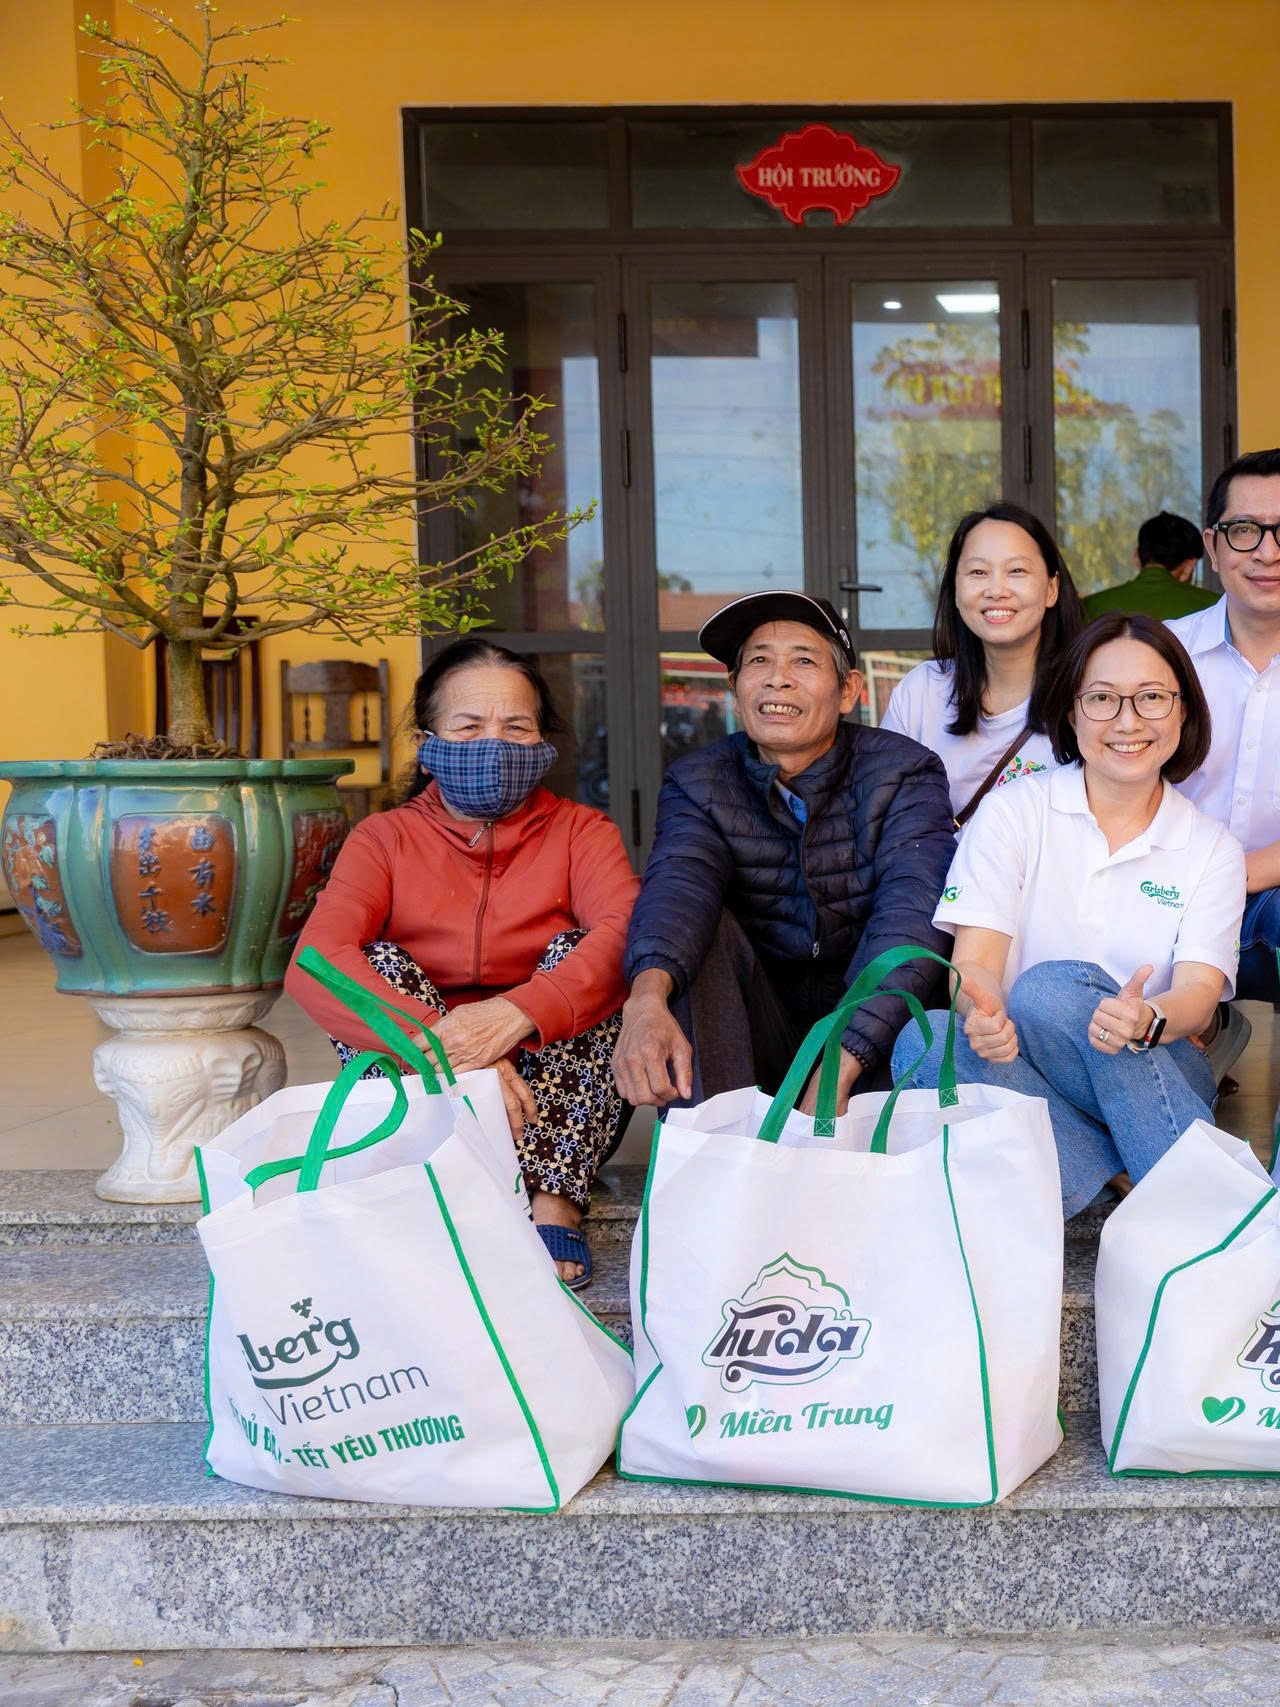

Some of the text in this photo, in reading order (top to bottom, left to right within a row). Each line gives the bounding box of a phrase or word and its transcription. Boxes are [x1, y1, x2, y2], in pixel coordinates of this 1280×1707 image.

[758, 163, 881, 190] HỘI TRƯỜNG
[1140, 881, 1180, 900] Carlsberg
[709, 1303, 860, 1358] huda
[261, 1366, 429, 1426] Vietnam
[330, 1434, 378, 1465] YÊU
[378, 1414, 466, 1453] THƯƠNG
[719, 1401, 895, 1439] Miền Trung
